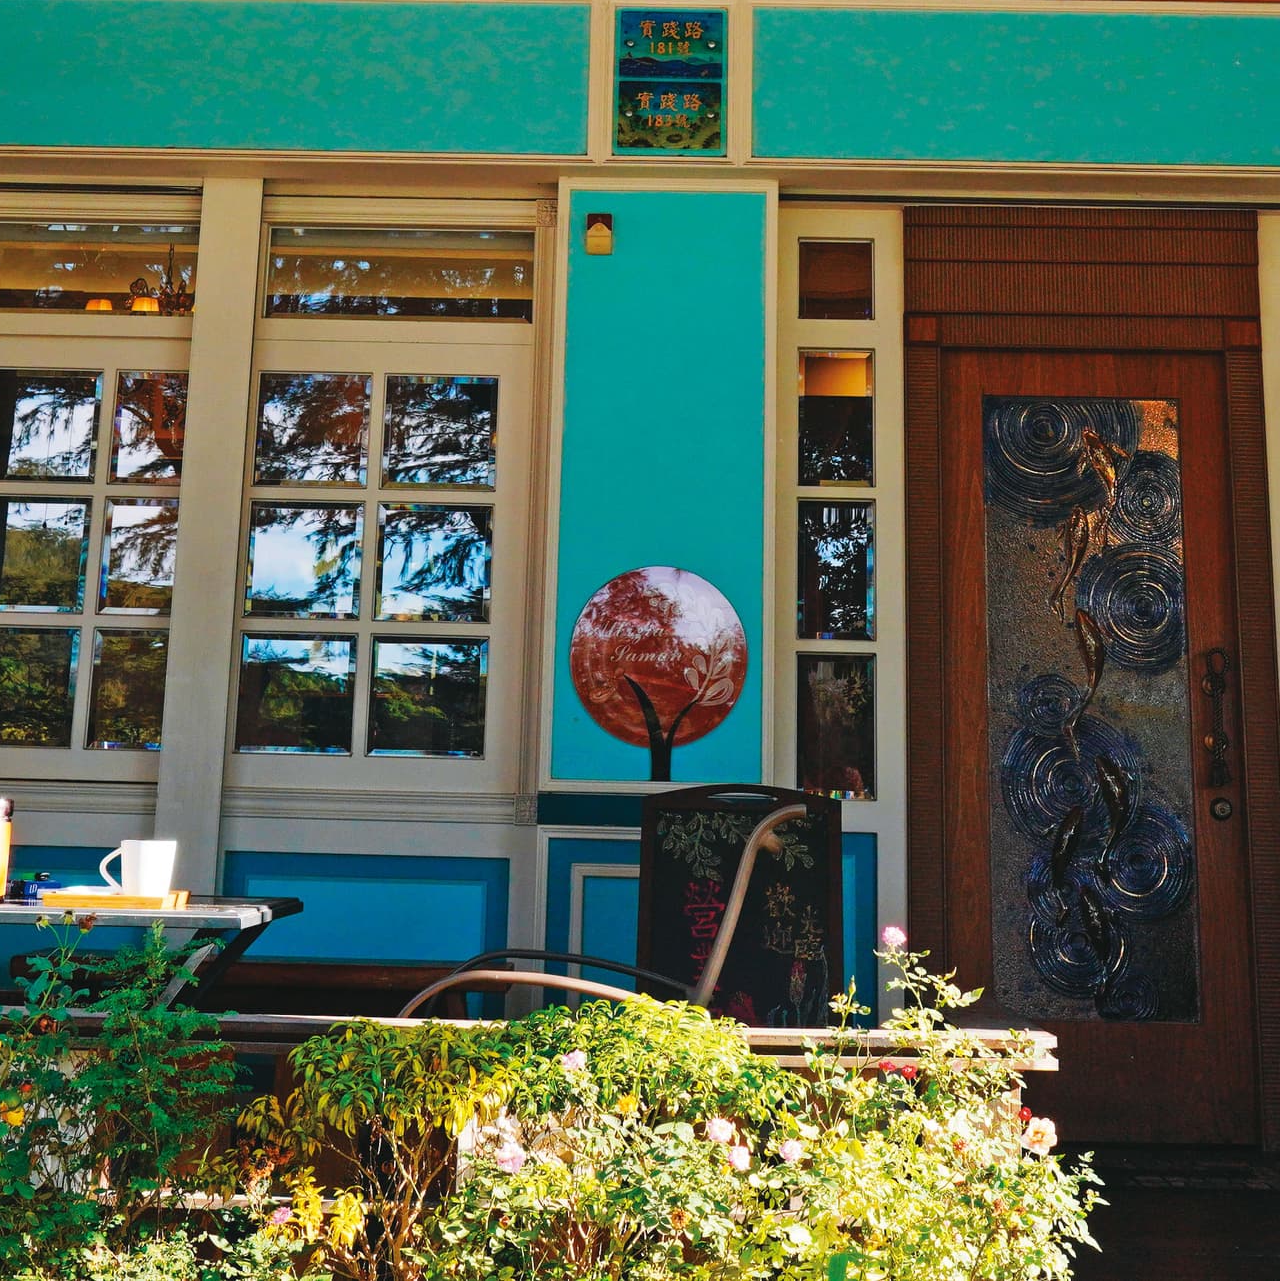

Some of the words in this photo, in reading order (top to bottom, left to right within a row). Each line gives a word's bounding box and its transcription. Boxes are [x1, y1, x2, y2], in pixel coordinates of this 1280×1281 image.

[640, 20, 704, 39] 實踐路
[650, 42, 691, 55] 181號
[636, 92, 702, 111] 實踐路
